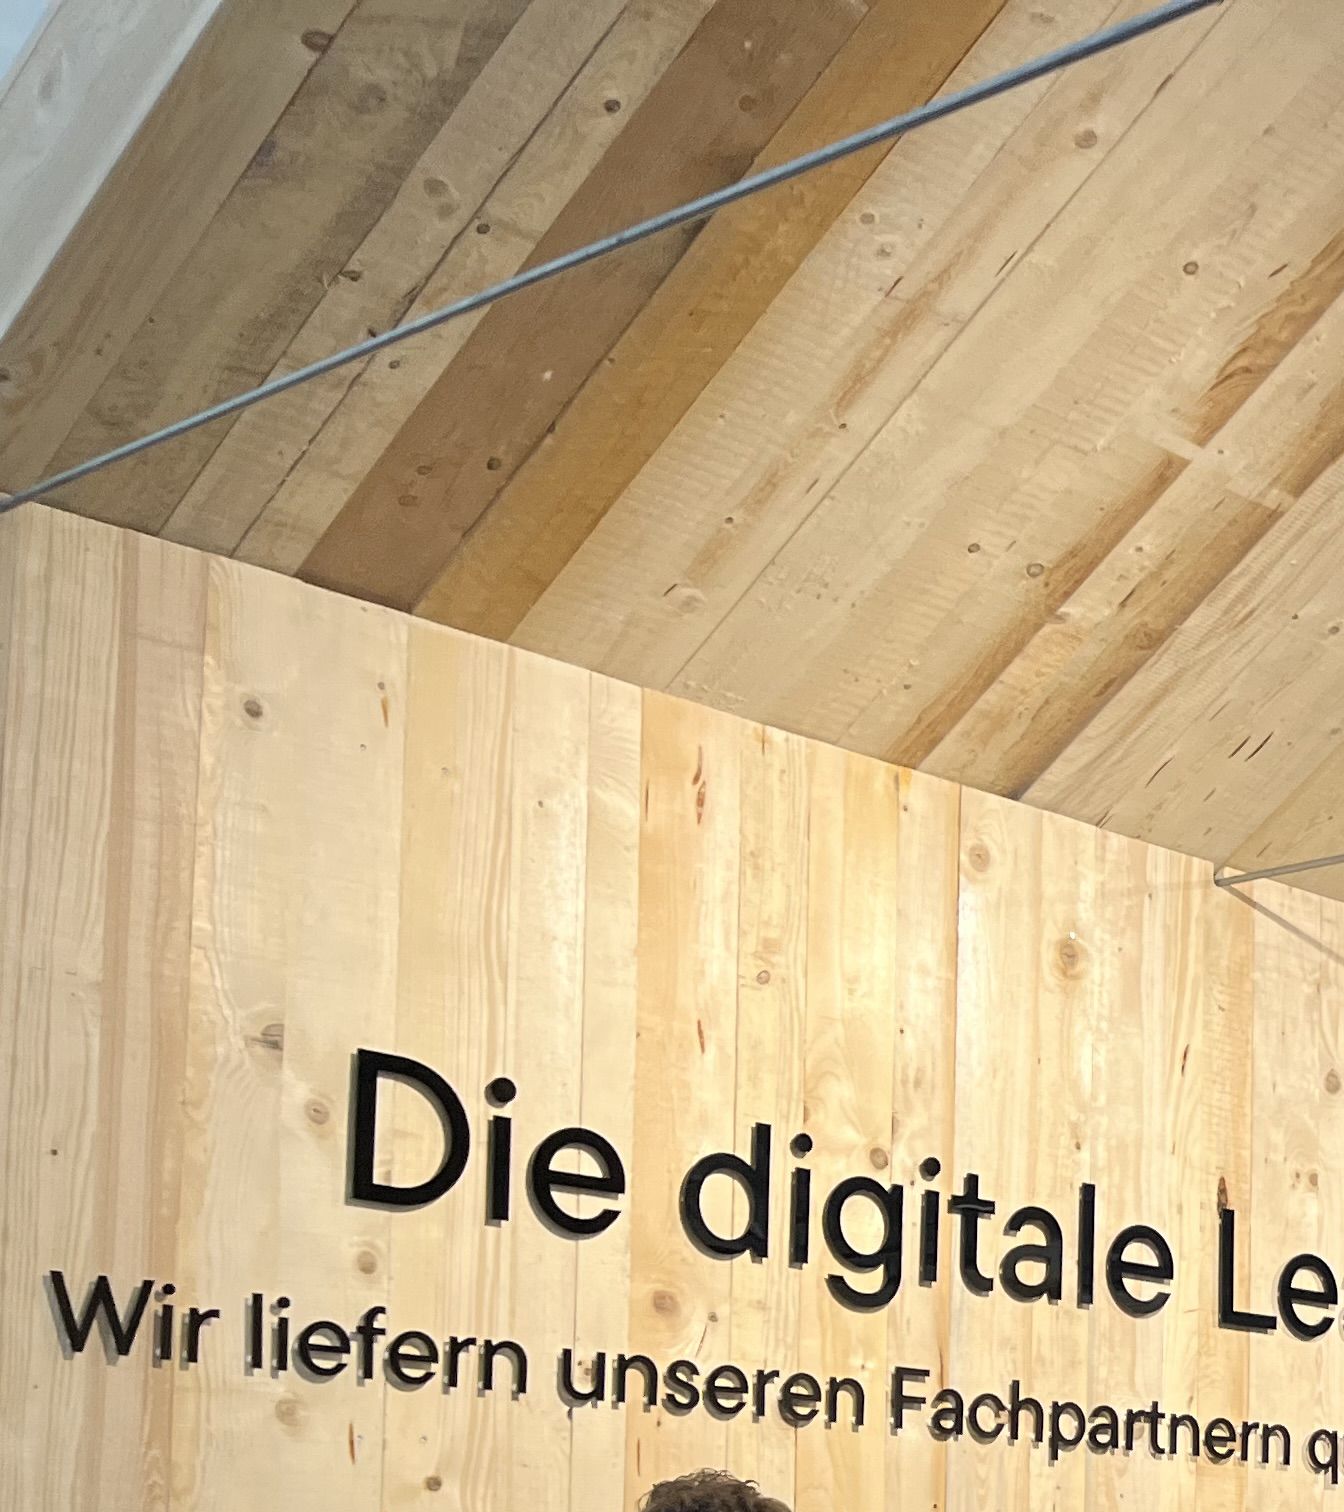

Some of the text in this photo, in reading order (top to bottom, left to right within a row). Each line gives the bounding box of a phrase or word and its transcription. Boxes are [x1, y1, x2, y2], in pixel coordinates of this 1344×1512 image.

[349, 1048, 627, 1237] Die
[678, 1123, 1175, 1318] digitale
[48, 1270, 220, 1364] Wir
[247, 1293, 529, 1396] liefern
[560, 1348, 866, 1427] unseren
[891, 1365, 1291, 1466] Fachpartnern
